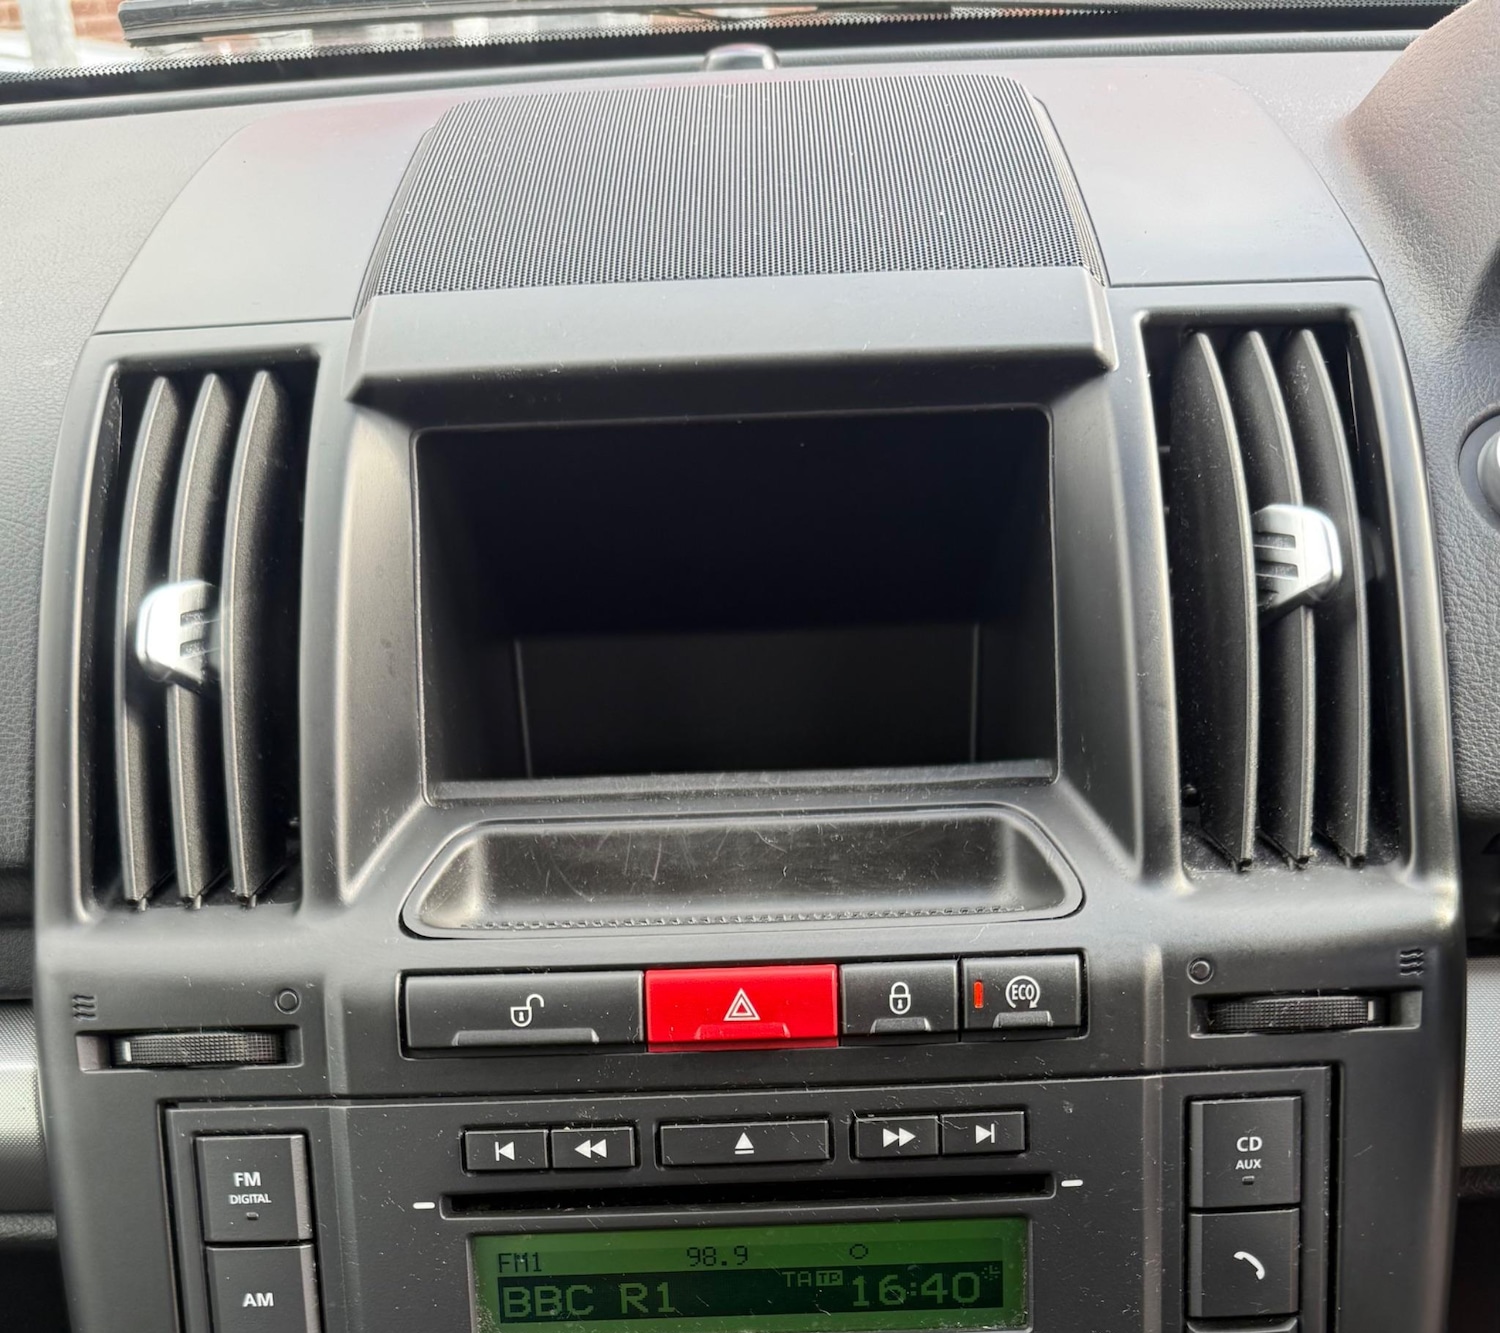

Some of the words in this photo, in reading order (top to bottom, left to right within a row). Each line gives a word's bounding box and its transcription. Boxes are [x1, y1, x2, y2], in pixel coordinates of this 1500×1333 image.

[1010, 983, 1036, 1001] ECO
[1236, 1136, 1263, 1152] CD
[1235, 1158, 1262, 1170] AUX
[233, 1171, 262, 1187] FM
[228, 1193, 272, 1205] DIGITAL
[499, 1252, 542, 1272] FM1
[686, 1245, 749, 1267] 98.9
[852, 1272, 981, 1307] 16:40
[242, 1292, 274, 1308] AM
[503, 1284, 593, 1318] BBC
[620, 1281, 677, 1314] R1
